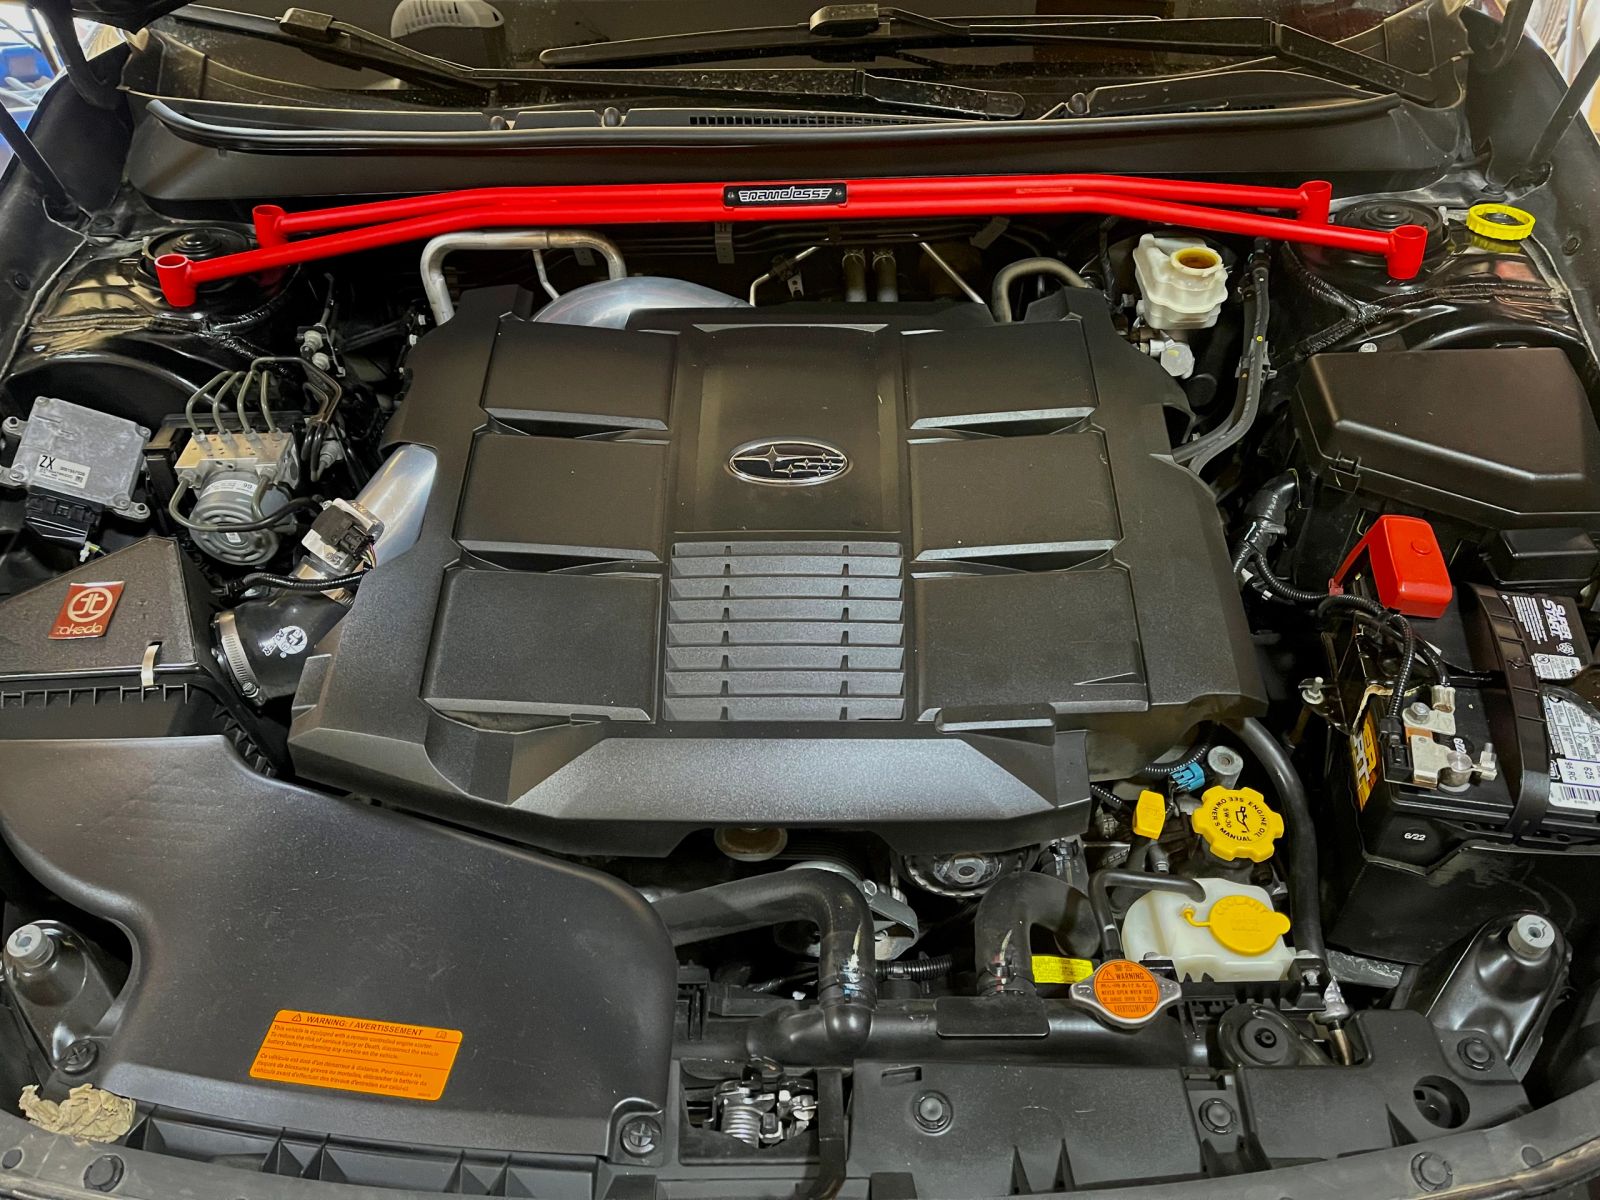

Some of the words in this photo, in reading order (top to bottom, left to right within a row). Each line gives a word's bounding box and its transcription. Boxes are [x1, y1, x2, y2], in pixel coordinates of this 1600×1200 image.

[745, 185, 823, 201] nameless
[39, 455, 56, 470] ZX
[1541, 597, 1563, 639] START
[1554, 603, 1573, 641] SUPER
[1248, 801, 1268, 826] ENGINE
[1219, 827, 1252, 842] MANUAL
[1255, 827, 1266, 837] OIL
[1403, 832, 1426, 841] 6/22
[1115, 972, 1144, 980] WARNING
[353, 1021, 424, 1036] AVERTISSEMENT
